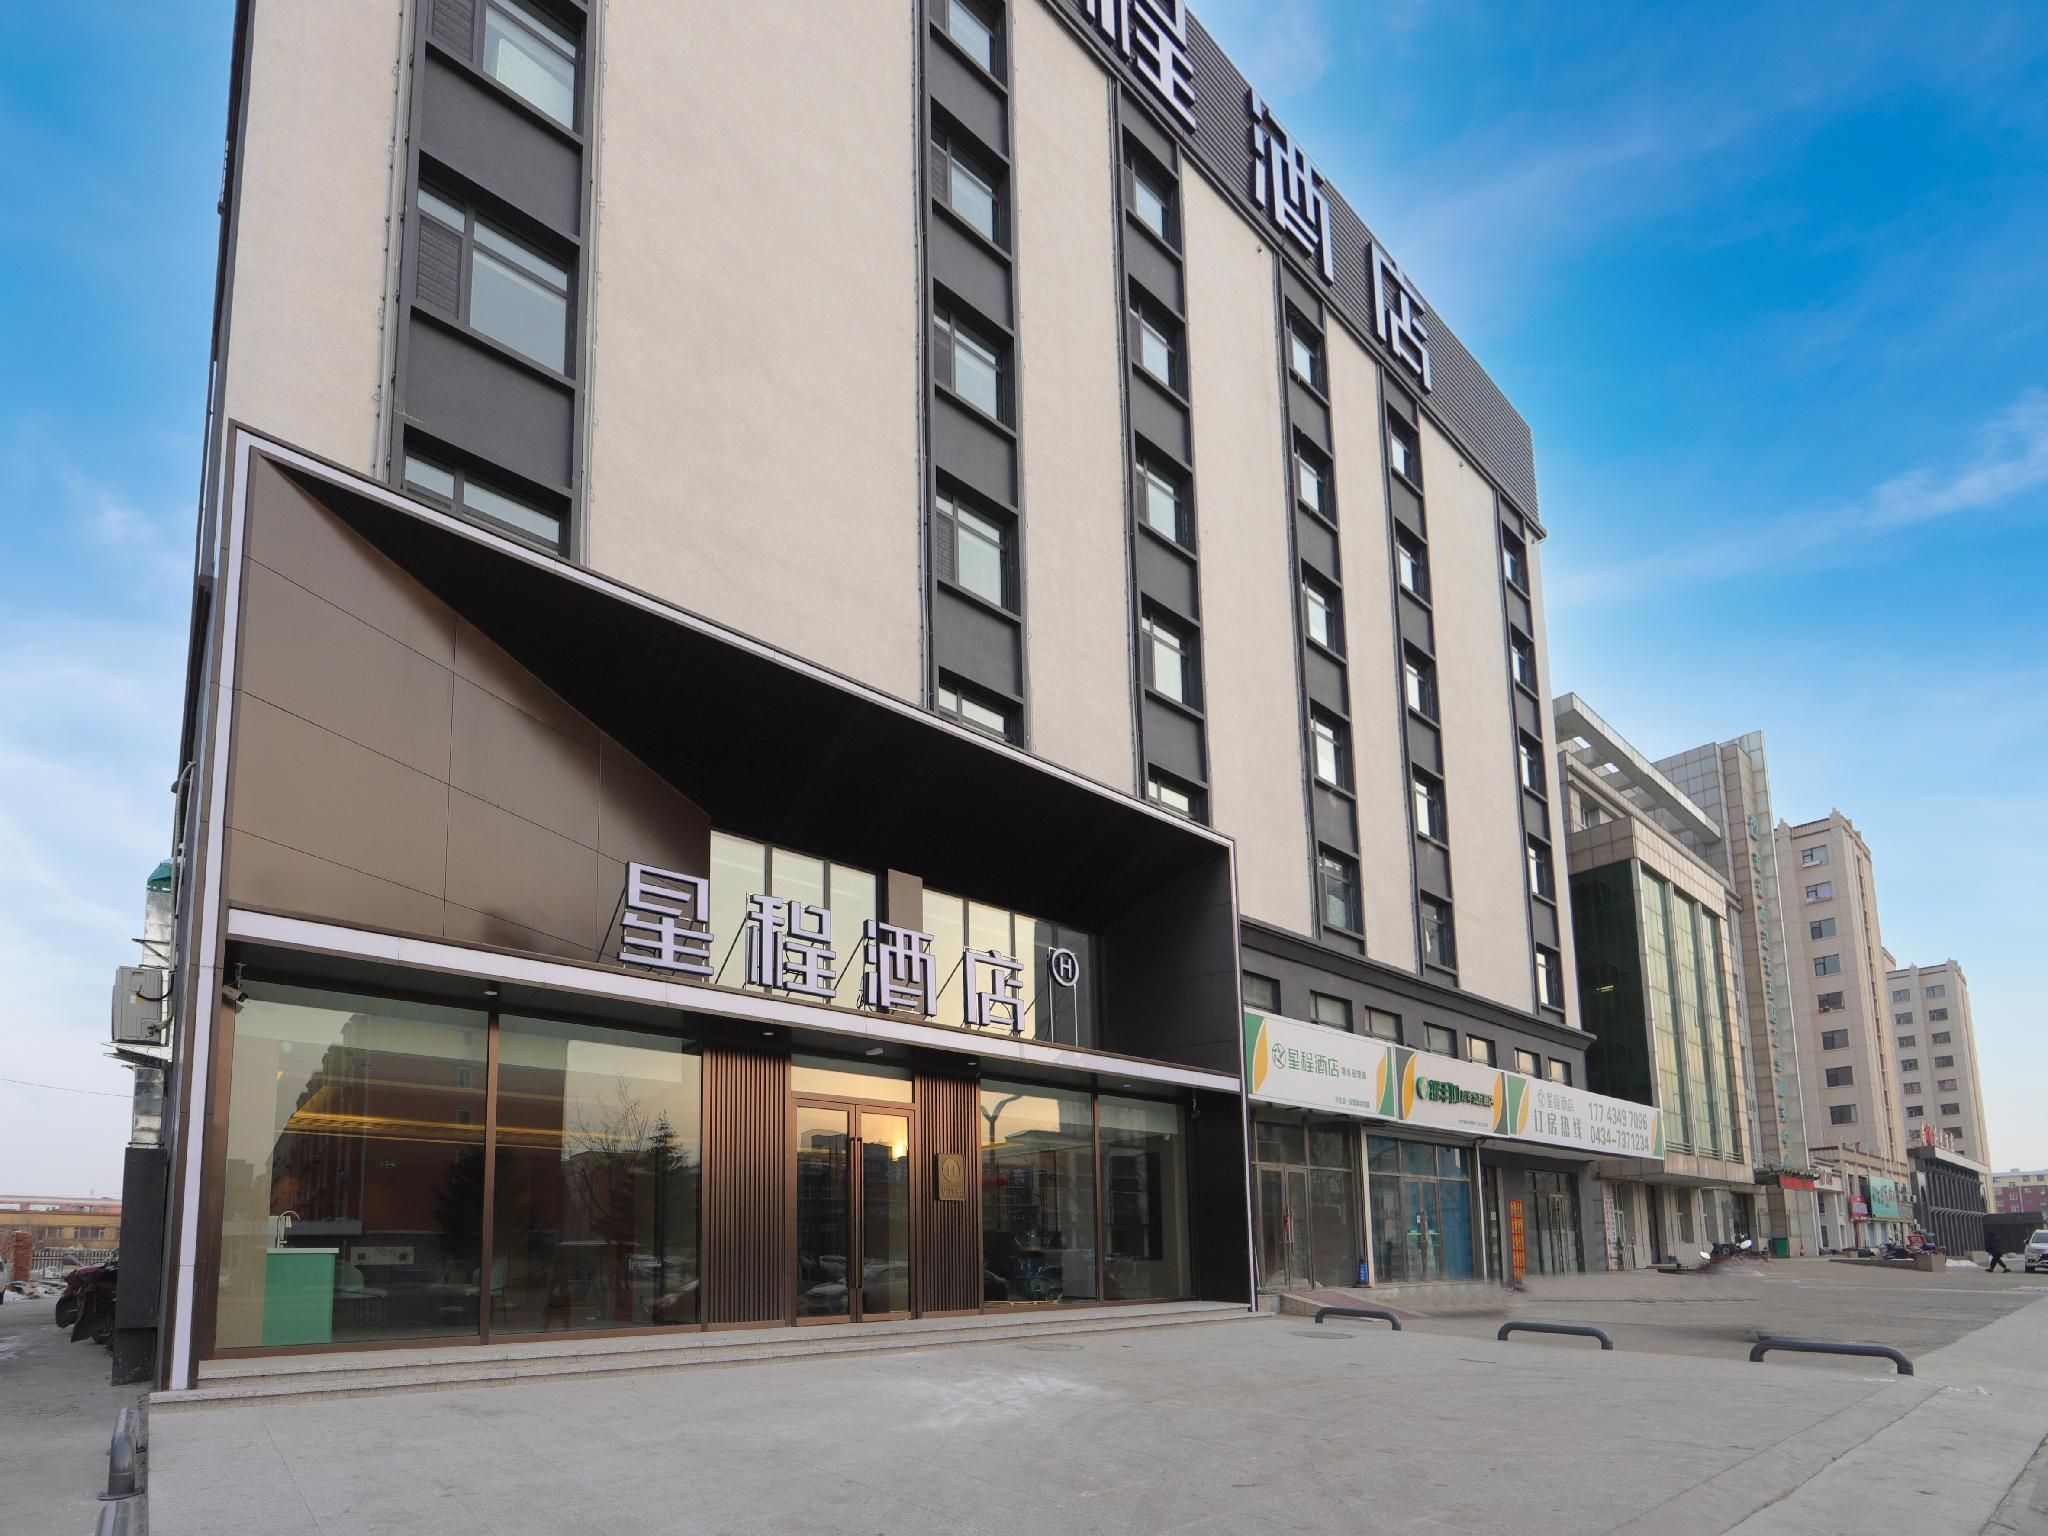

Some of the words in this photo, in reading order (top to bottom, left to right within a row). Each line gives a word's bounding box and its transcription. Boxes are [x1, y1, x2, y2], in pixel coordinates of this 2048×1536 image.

[617, 861, 1025, 1033] 星程酒店
[1287, 1048, 1340, 1078] 星程酒店
[1546, 1093, 1575, 1113] 星程酒店
[1588, 1101, 1604, 1123] 177
[1606, 1105, 1627, 1127] 4349
[1534, 1109, 1583, 1140] 订房热线
[1590, 1125, 1650, 1154] 0434-7371234
